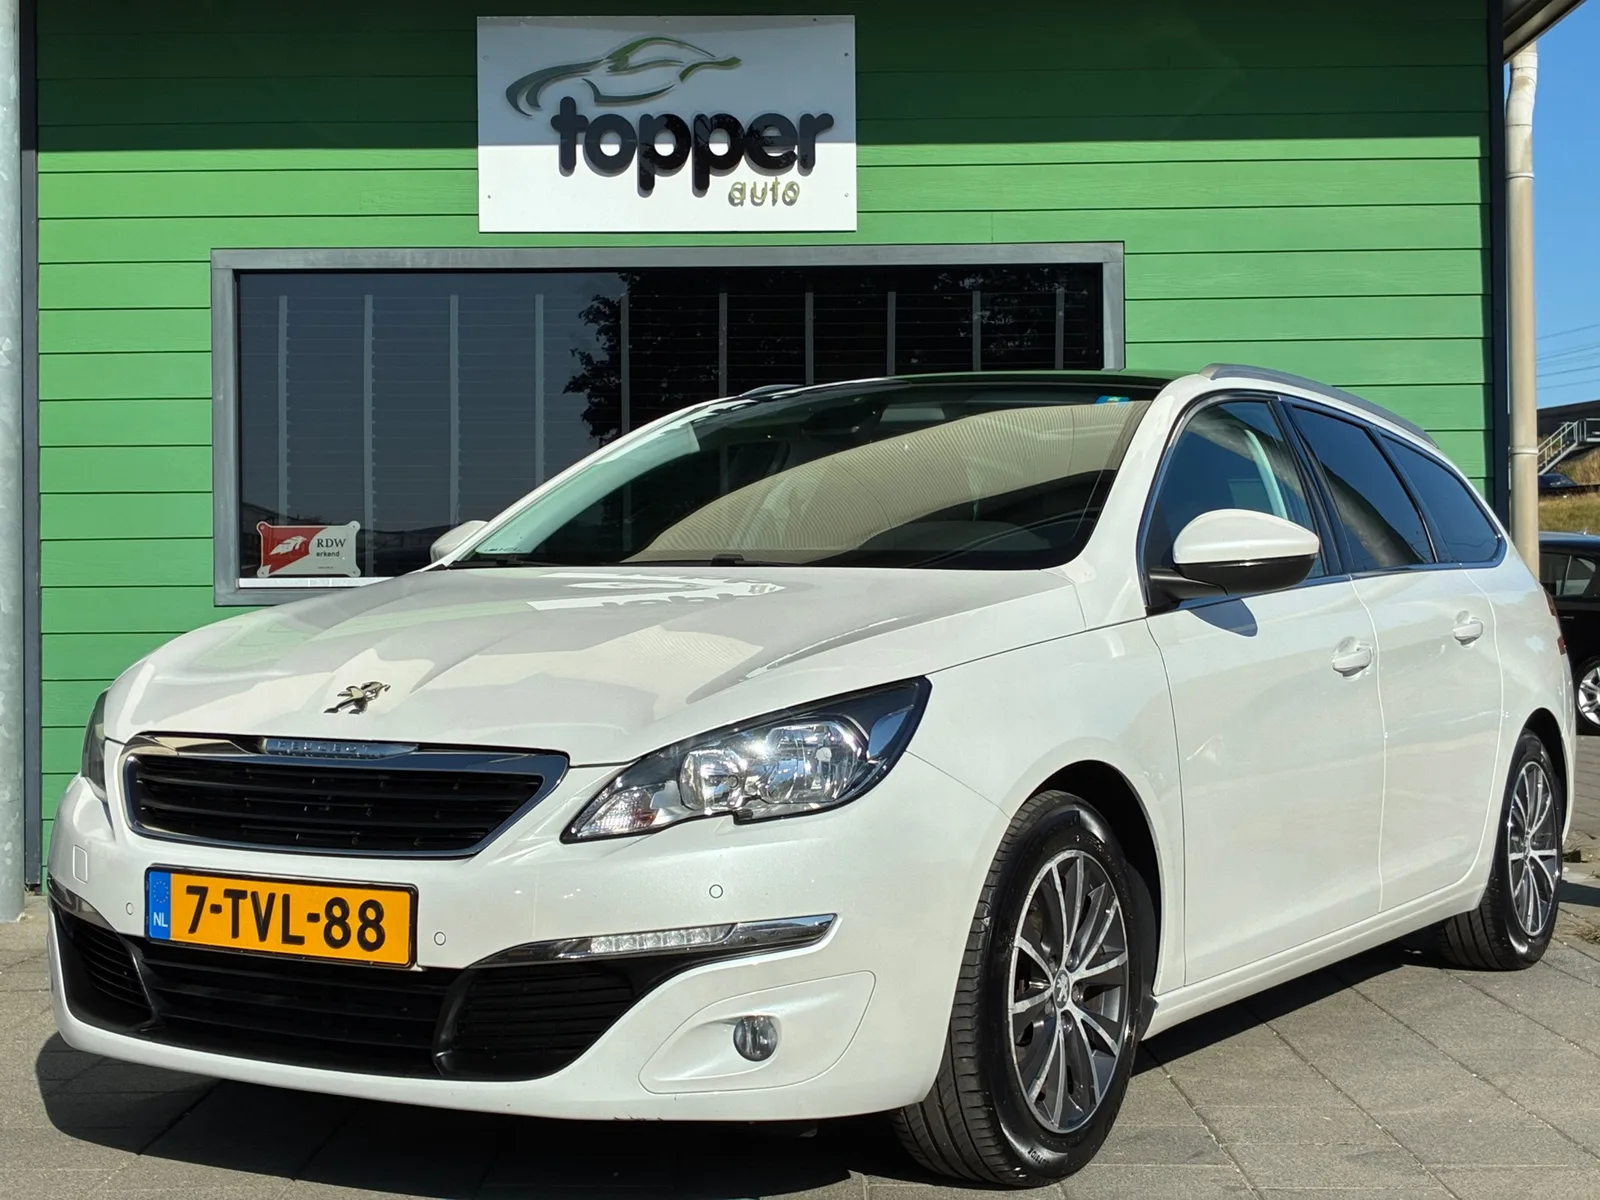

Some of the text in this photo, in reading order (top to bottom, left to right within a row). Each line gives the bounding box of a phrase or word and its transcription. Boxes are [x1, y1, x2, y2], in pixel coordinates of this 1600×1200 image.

[551, 96, 834, 194] topper
[729, 177, 800, 205] auto
[316, 538, 346, 548] RDW
[153, 885, 386, 952] NL 7-TVL-88
